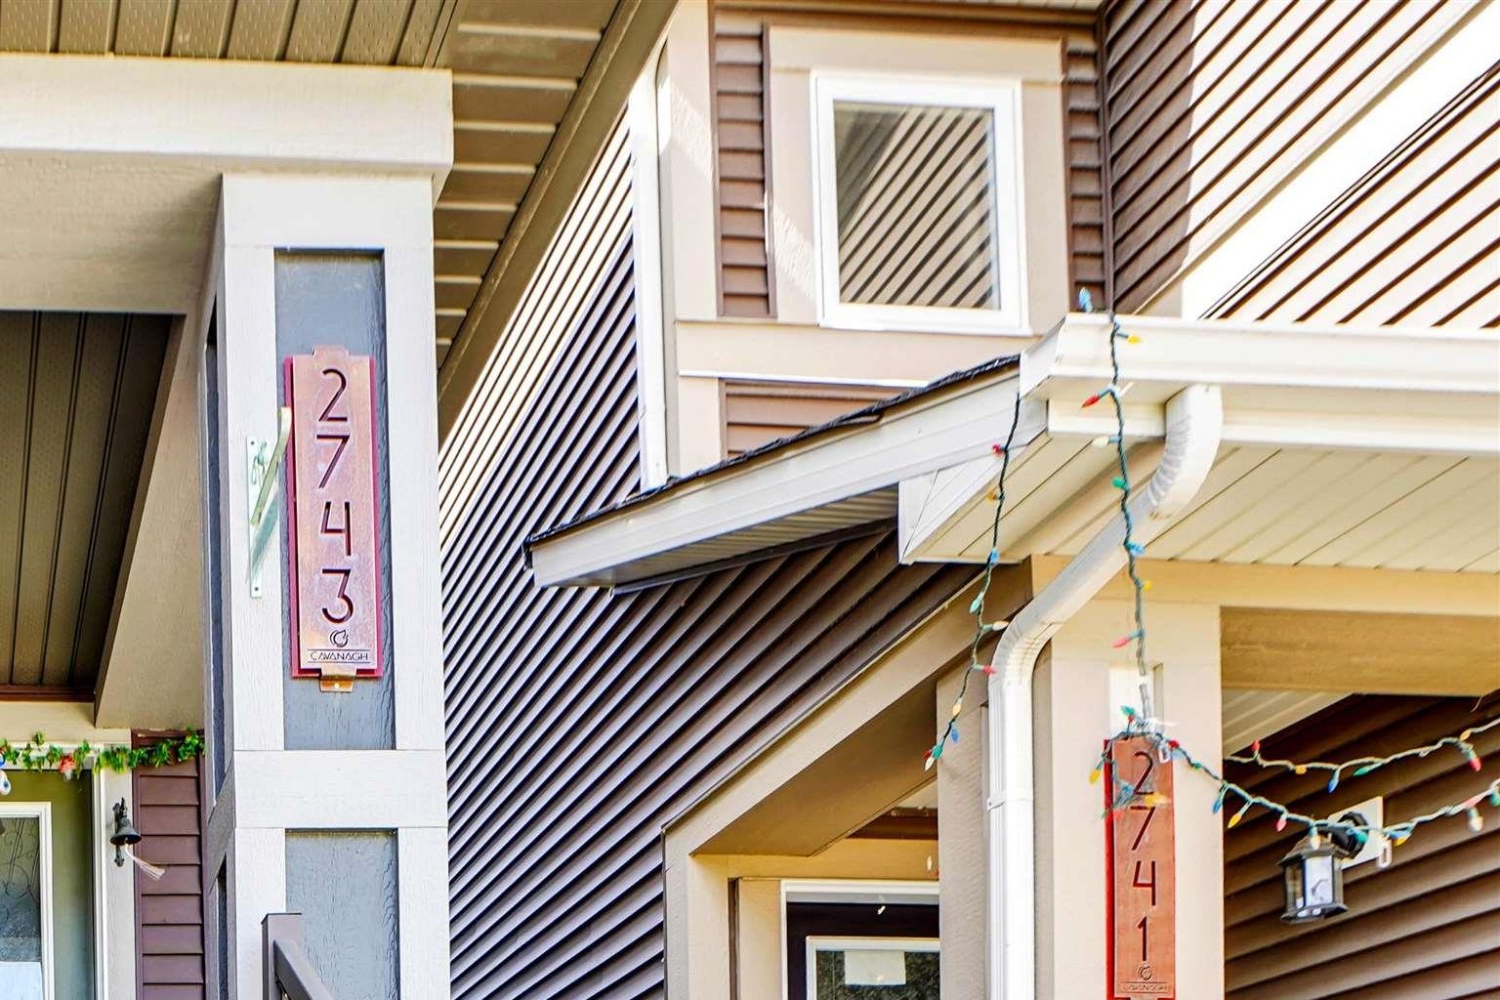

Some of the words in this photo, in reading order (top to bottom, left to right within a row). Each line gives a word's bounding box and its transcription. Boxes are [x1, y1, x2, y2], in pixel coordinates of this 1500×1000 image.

[316, 368, 354, 624] 2743
[310, 651, 368, 661] CAVANAGH
[1130, 752, 1156, 962] 2741
